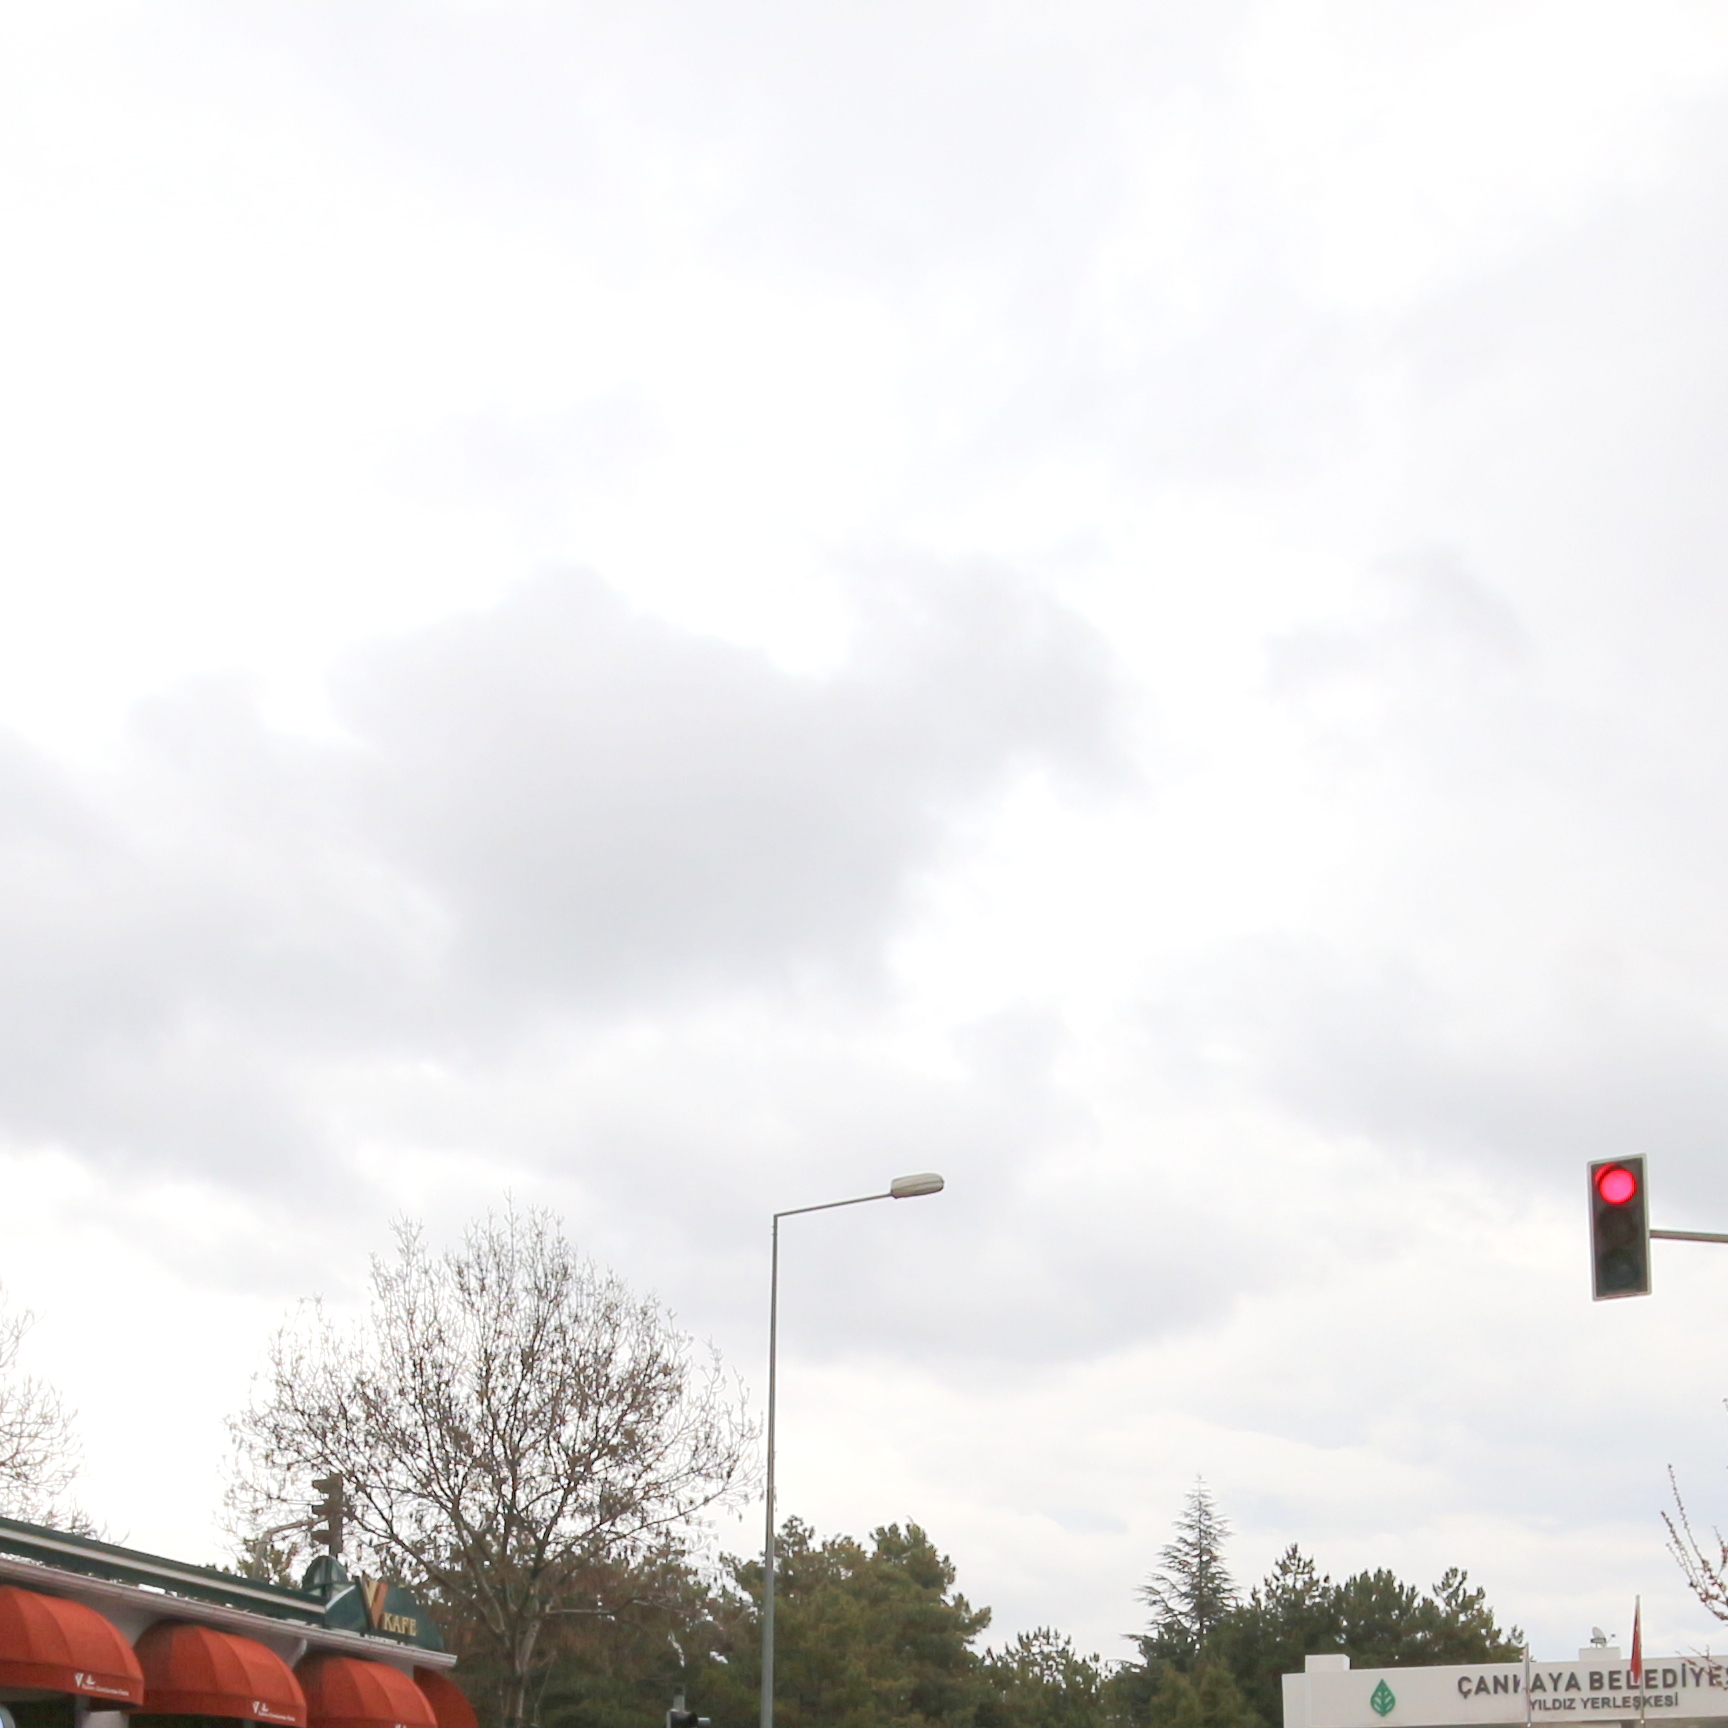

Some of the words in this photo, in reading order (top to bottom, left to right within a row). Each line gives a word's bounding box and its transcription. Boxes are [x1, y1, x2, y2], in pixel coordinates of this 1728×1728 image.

[383, 1612, 417, 1637] KAFE
[1457, 1671, 1582, 1699] ÇANKAYA
[1530, 1698, 1576, 1712] YILDIZ
[1580, 1691, 1679, 1711] YERLEŞKESİ
